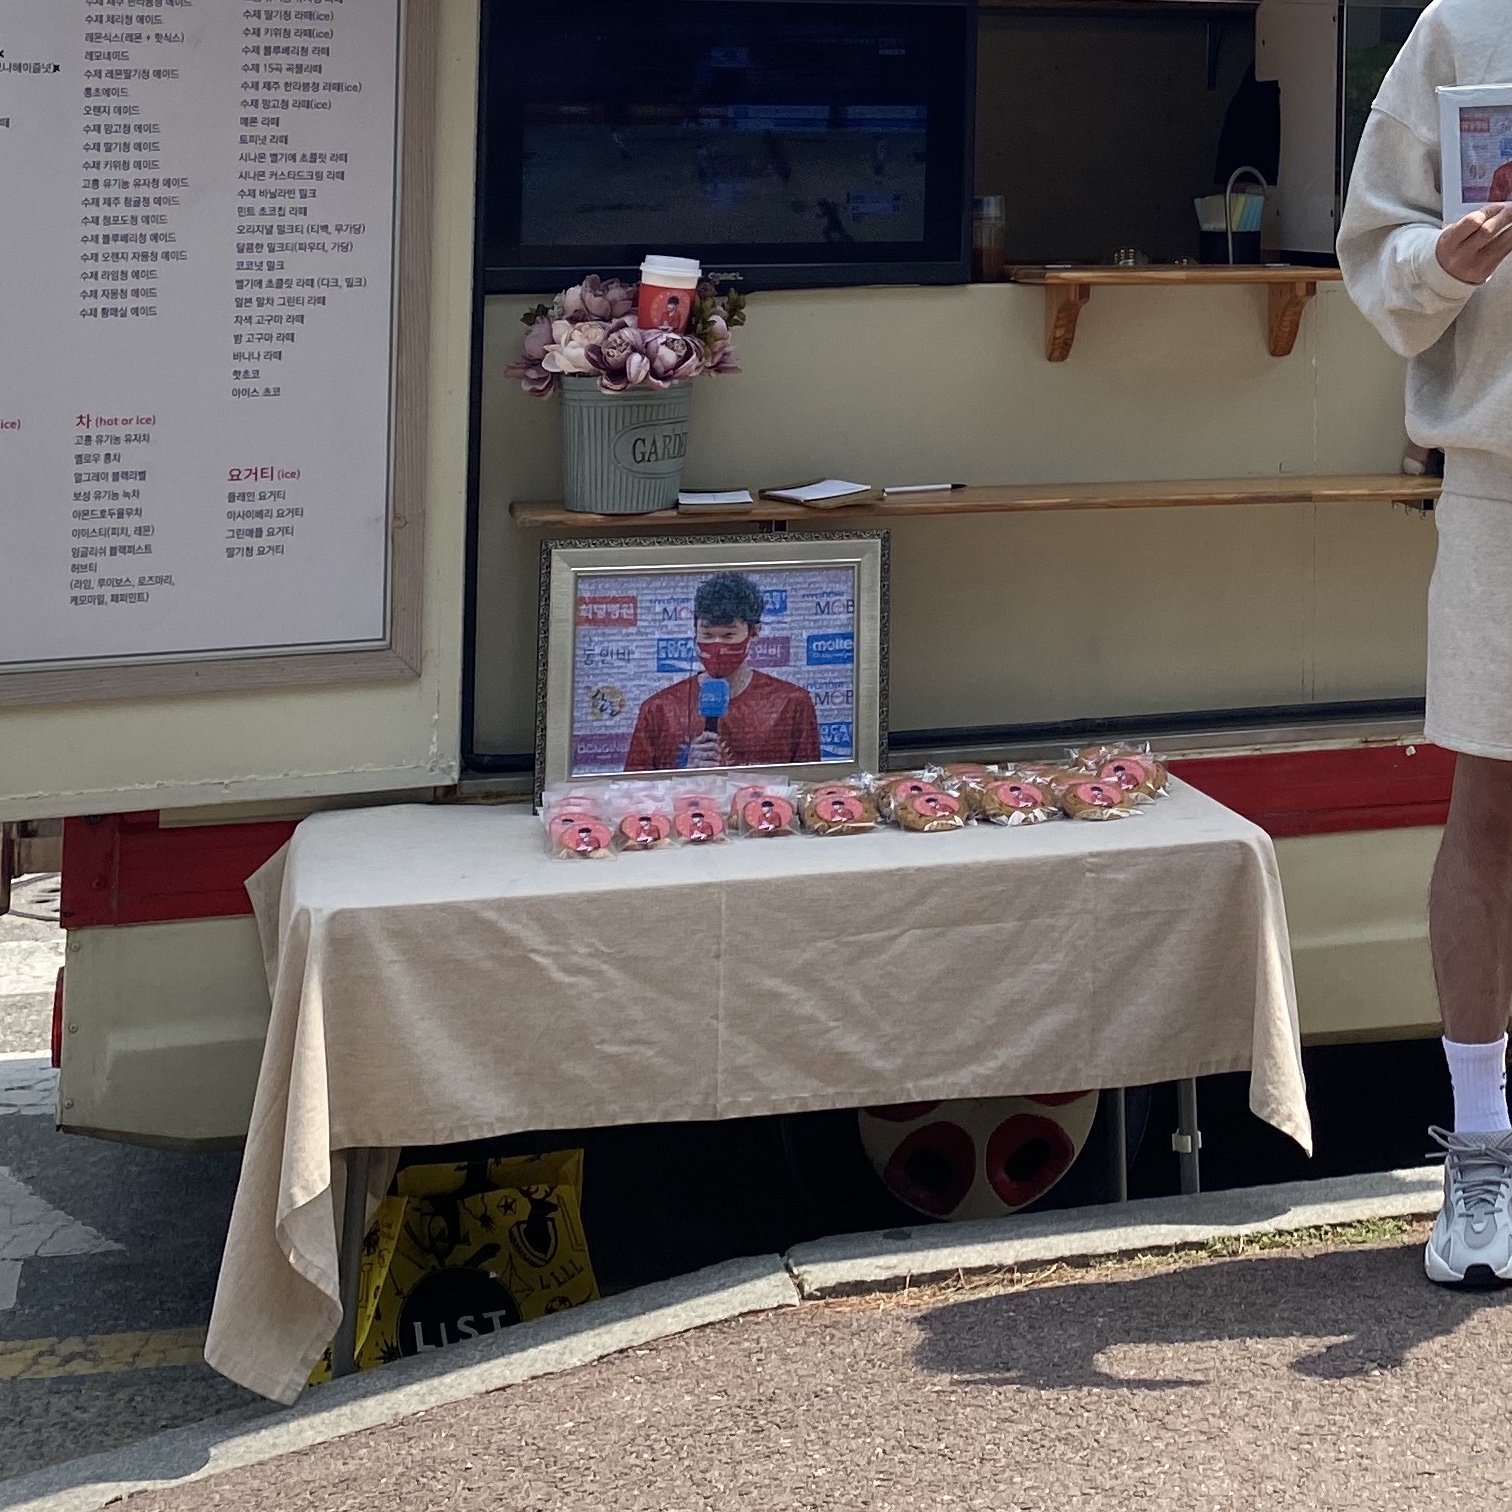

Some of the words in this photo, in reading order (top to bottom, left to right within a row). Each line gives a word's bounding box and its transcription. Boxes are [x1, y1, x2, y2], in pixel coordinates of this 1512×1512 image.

[76, 414, 92, 429] 차
[96, 417, 119, 428] (hot
[136, 415, 156, 426] ice)
[227, 466, 274, 482] 요거티
[278, 469, 300, 480] (ice)
[812, 638, 854, 651] molte
